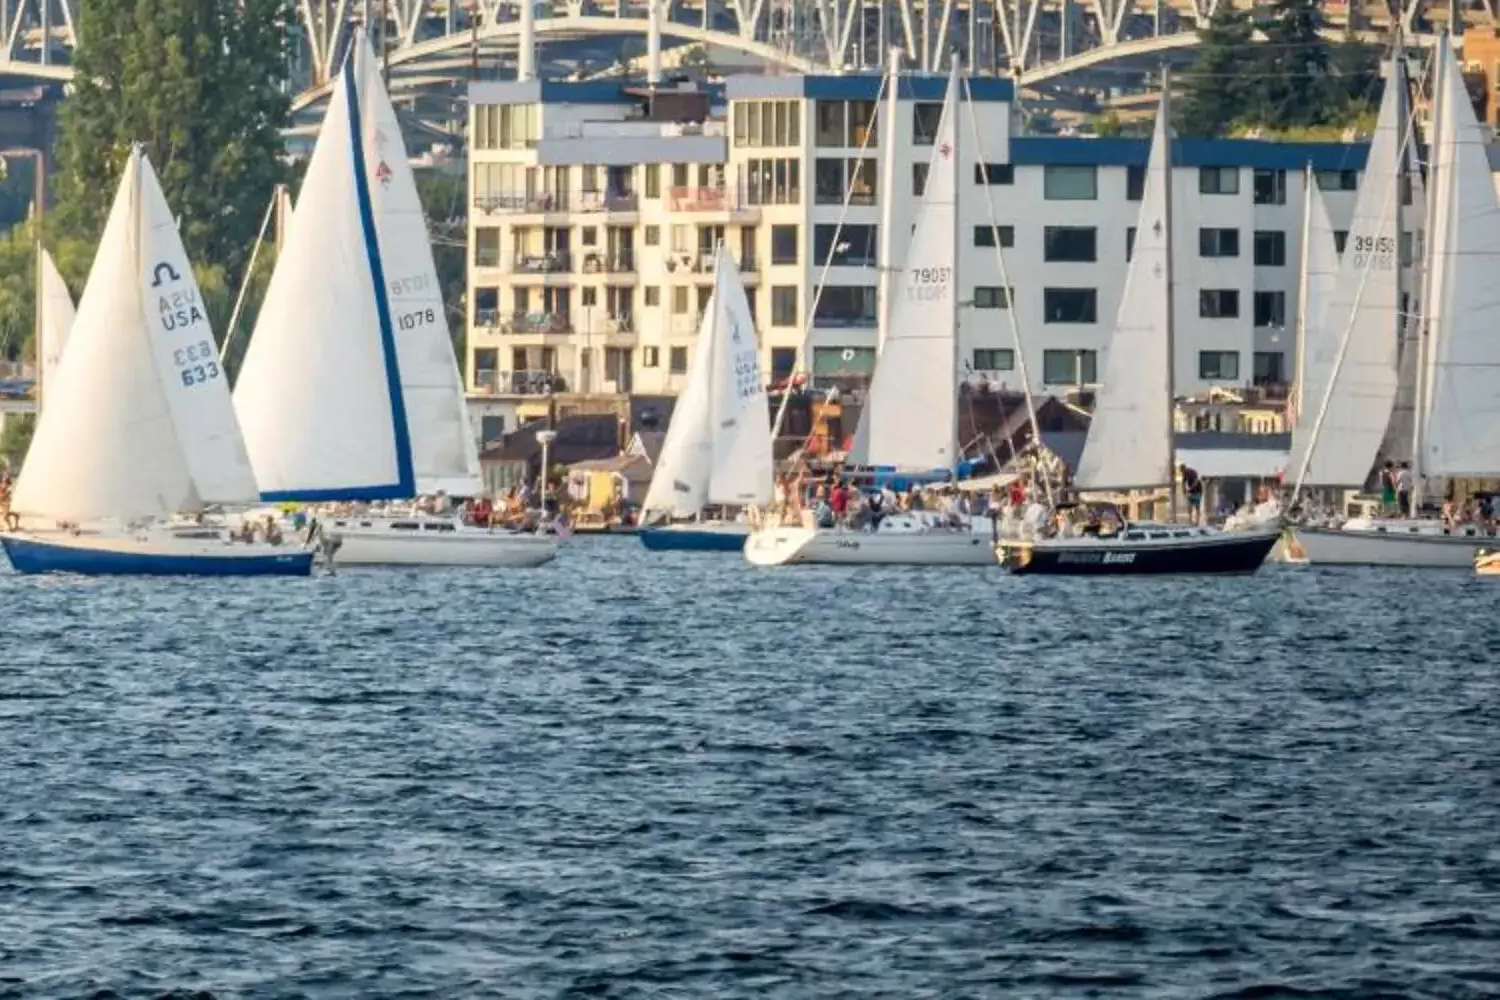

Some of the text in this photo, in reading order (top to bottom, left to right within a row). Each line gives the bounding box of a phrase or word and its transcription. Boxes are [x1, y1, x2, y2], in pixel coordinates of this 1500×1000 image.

[161, 306, 203, 331] USA
[397, 308, 435, 331] 1078
[181, 361, 219, 387] 633
